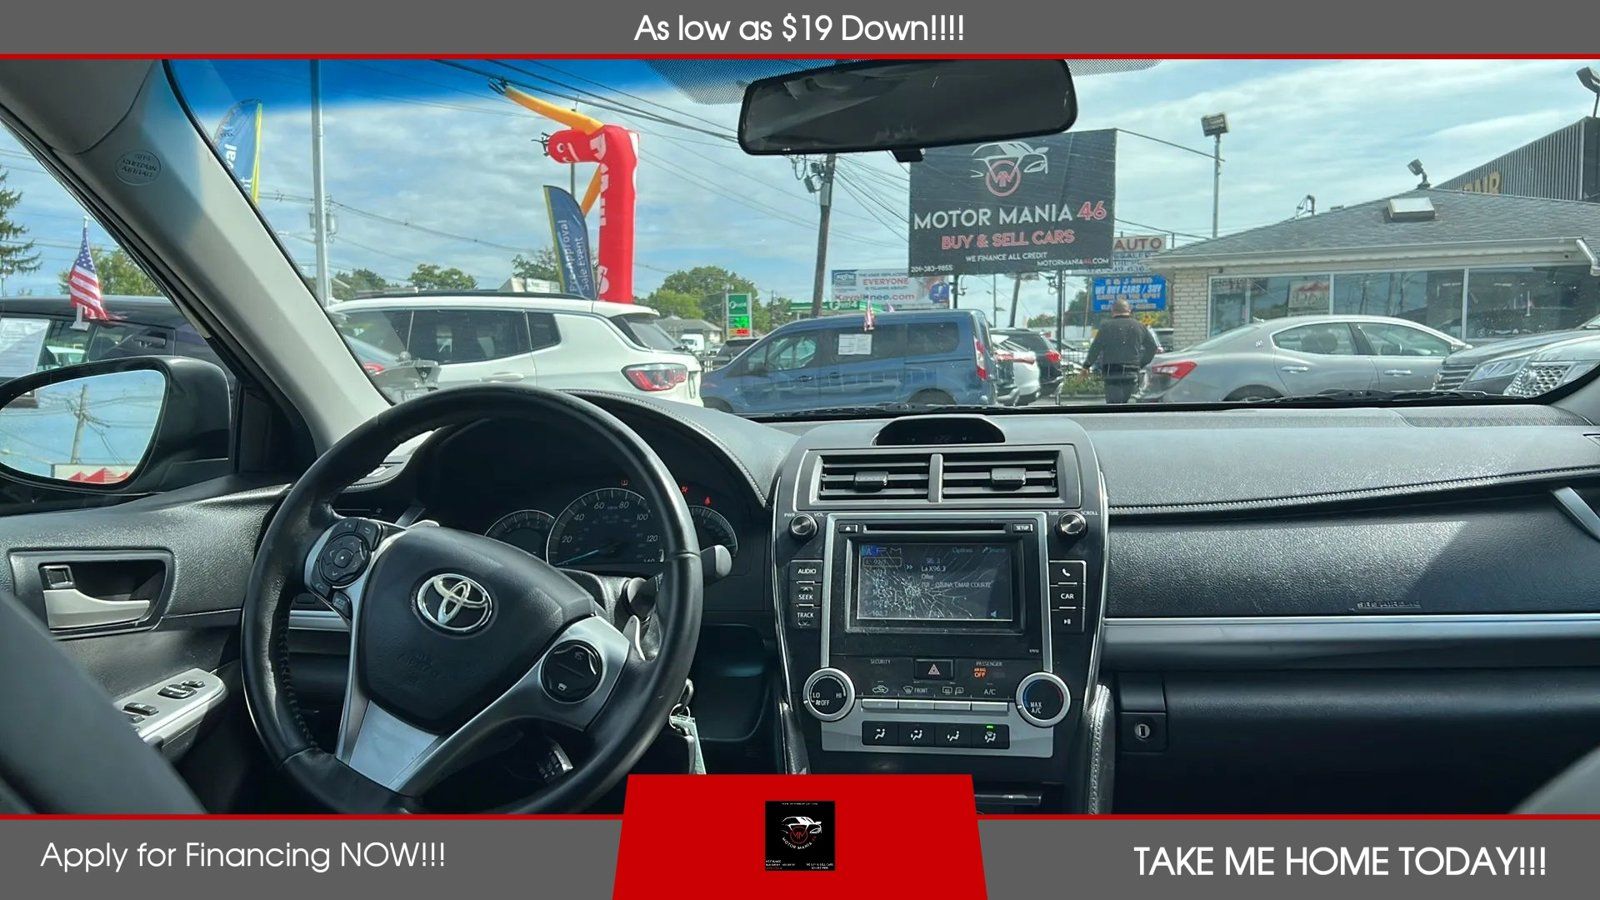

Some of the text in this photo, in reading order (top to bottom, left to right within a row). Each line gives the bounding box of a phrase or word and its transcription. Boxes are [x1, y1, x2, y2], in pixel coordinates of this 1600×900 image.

[914, 200, 1107, 230] MOTOR MANIA 46
[941, 228, 1076, 250] BUY & SELL CARS
[1114, 237, 1162, 250] AUTO
[574, 236, 590, 291] Sale Event
[977, 253, 1008, 262] FINANCE
[1022, 251, 1048, 260] CREDIT
[1121, 285, 1141, 294] CARS
